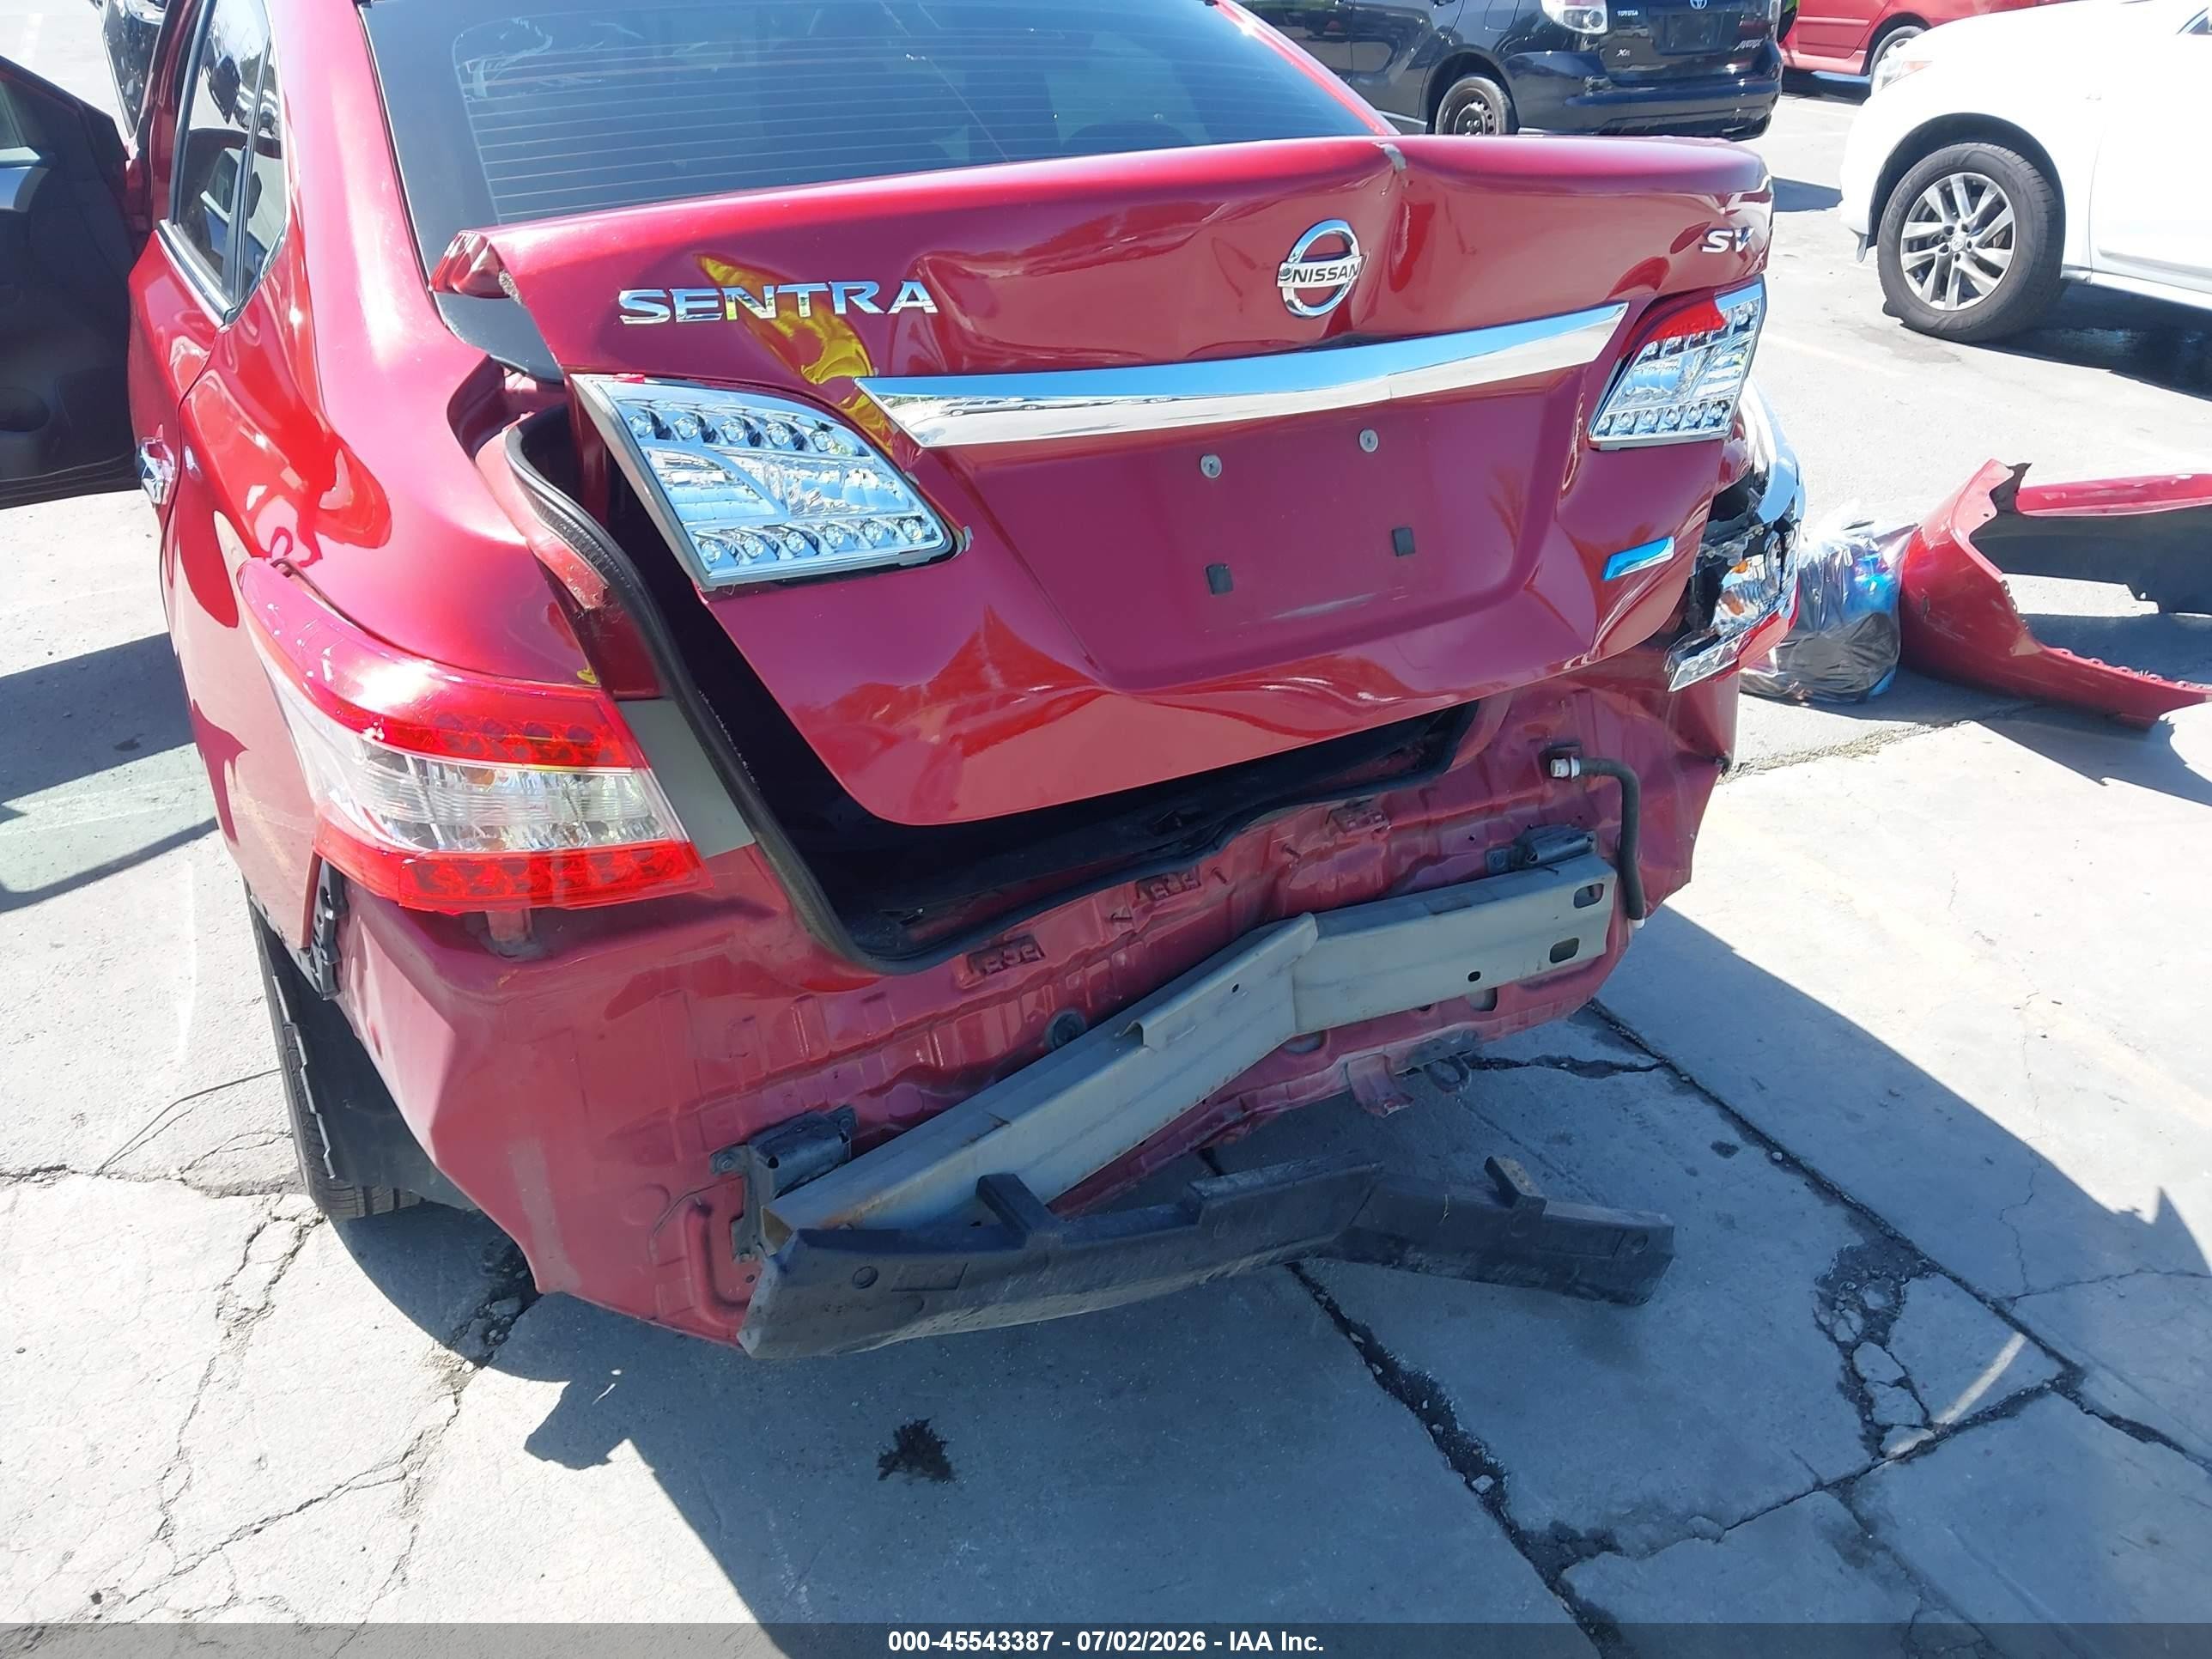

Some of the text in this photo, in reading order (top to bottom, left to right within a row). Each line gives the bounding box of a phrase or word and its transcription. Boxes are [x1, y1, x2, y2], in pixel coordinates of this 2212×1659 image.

[1700, 227, 1755, 252] SV
[1291, 264, 1359, 283] NISSAN
[617, 280, 939, 325] SENTRA
